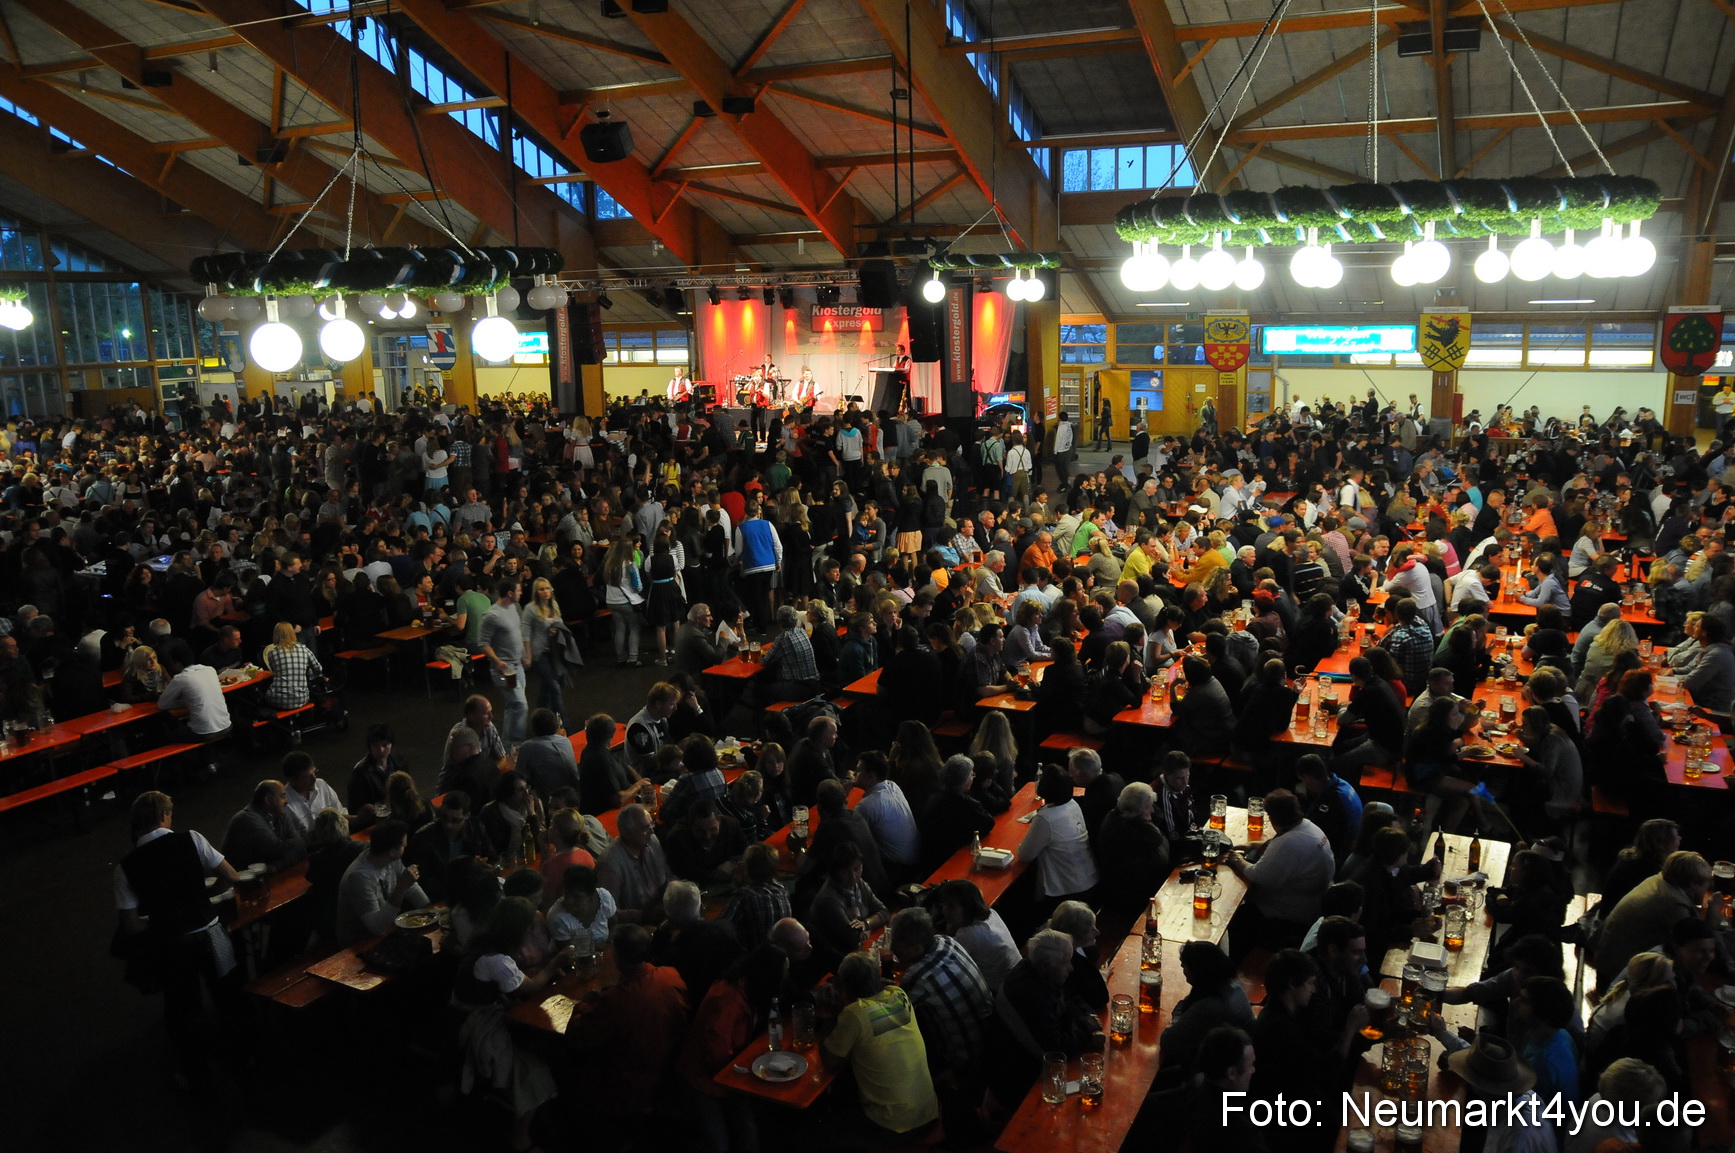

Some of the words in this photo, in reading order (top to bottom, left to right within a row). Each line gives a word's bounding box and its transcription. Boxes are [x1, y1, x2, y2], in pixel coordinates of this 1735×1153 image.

[558, 306, 569, 381] www.klostergold.d
[827, 318, 868, 329] Express
[951, 291, 962, 380] www.klostergold.de
